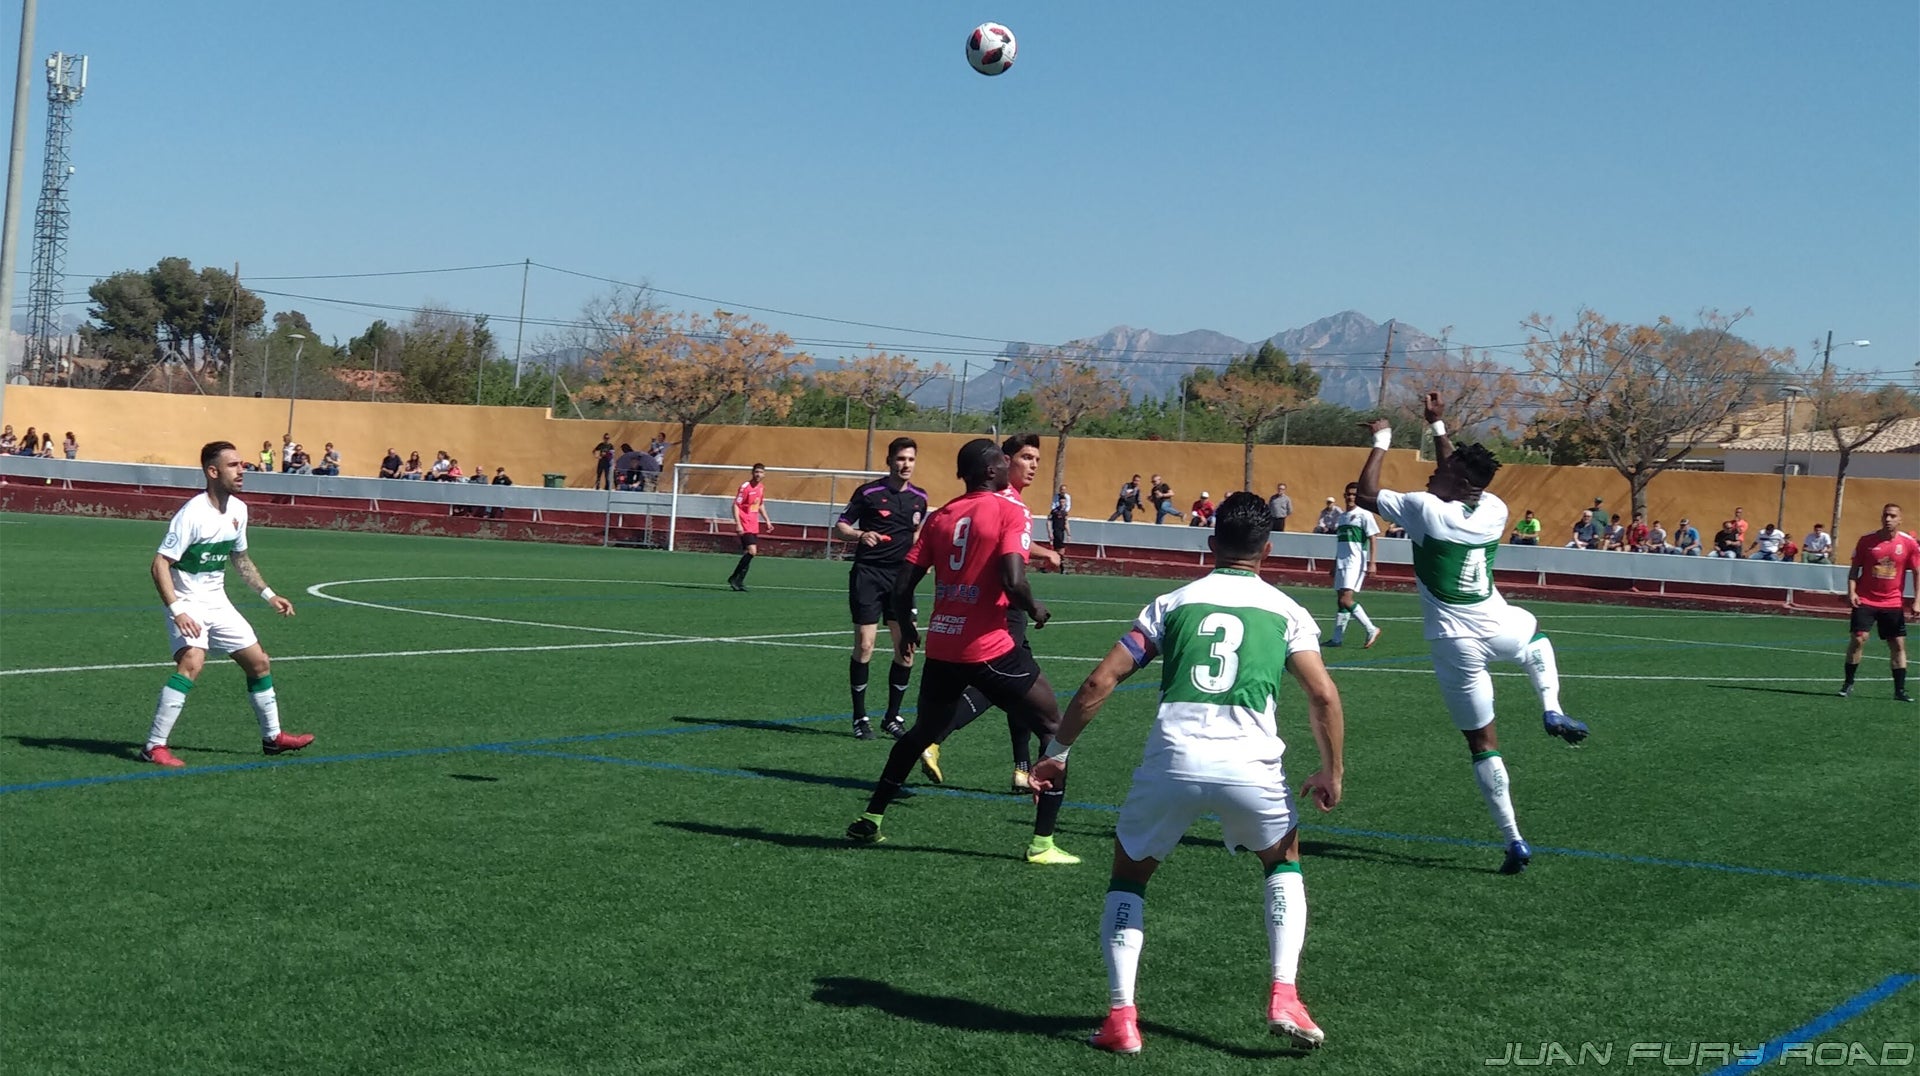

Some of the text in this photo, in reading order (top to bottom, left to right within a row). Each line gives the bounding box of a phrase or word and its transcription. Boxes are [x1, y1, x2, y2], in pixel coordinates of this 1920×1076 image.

[949, 516, 972, 571] 9
[1458, 547, 1490, 597] 4
[1190, 612, 1245, 694] 3
[1113, 902, 1131, 947] ELCHE CF
[1272, 886, 1287, 927] ELCHE CF
